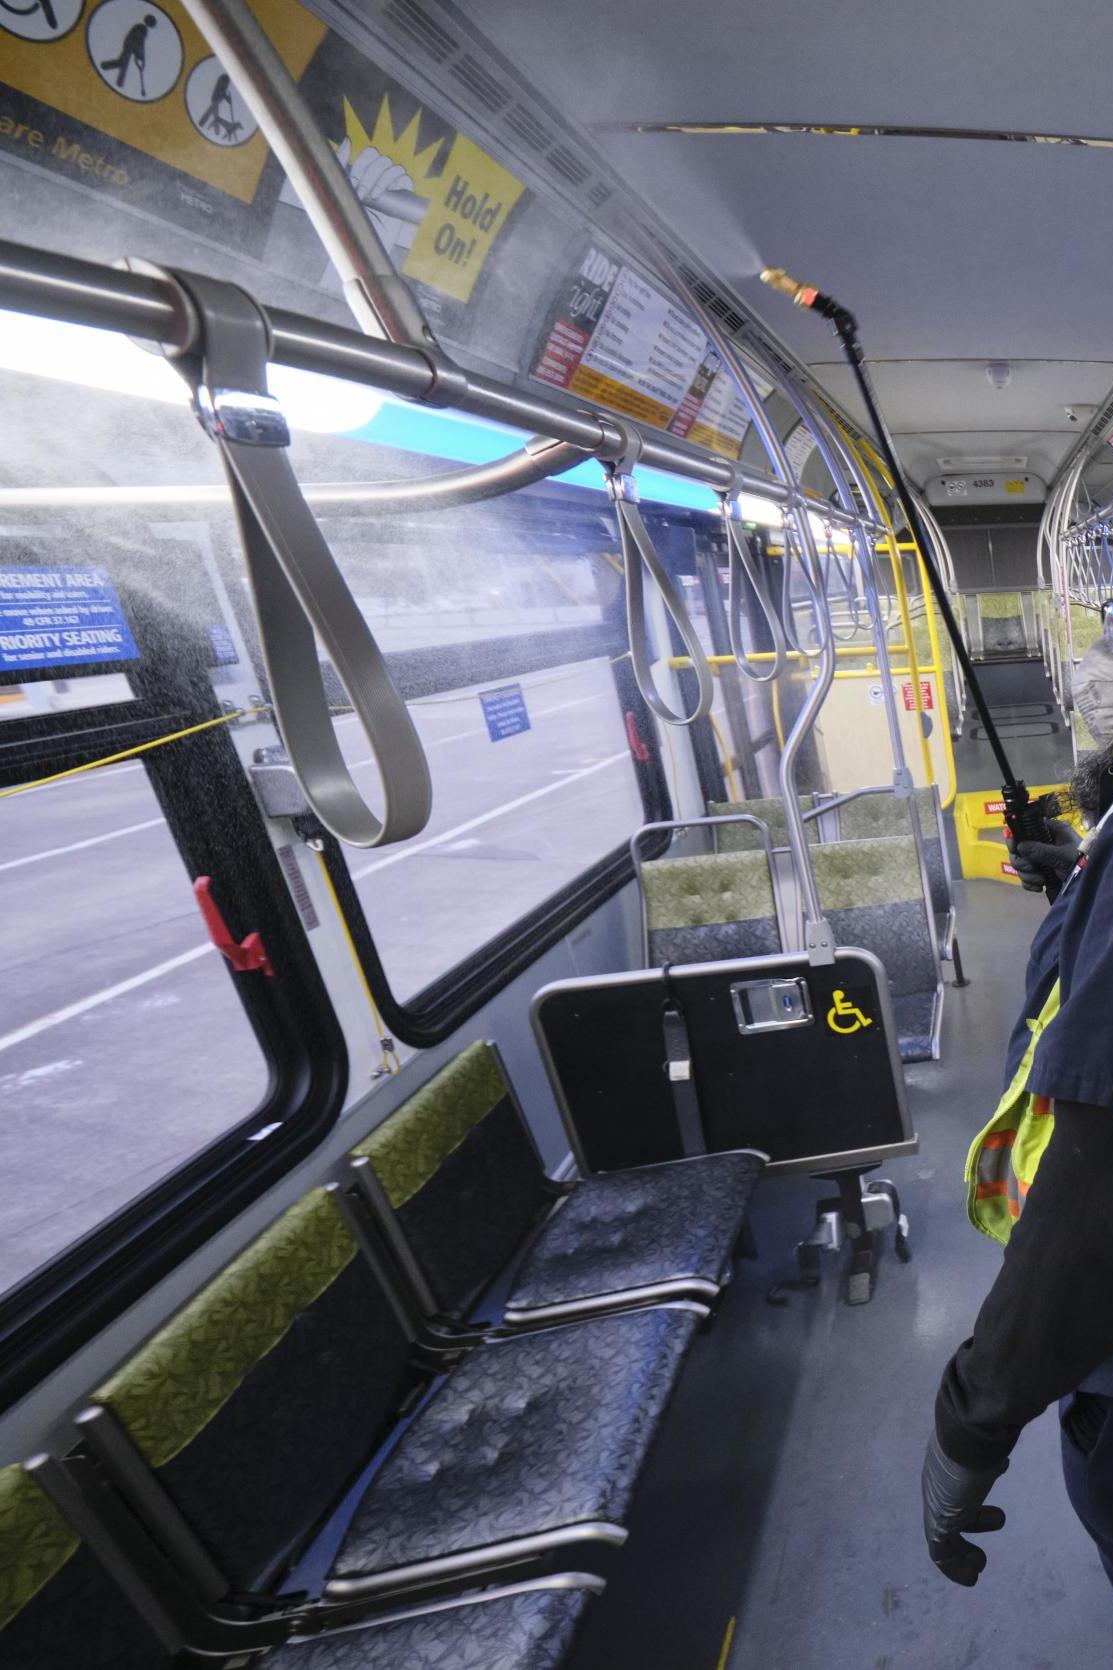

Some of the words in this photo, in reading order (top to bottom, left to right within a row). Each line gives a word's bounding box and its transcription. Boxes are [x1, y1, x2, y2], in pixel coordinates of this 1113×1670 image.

[51, 135, 129, 186] Metro
[444, 174, 502, 233] Hold
[434, 222, 477, 268] On!
[578, 248, 618, 293] RIDE
[65, 573, 104, 588] AREA
[62, 629, 123, 646] SEATING
